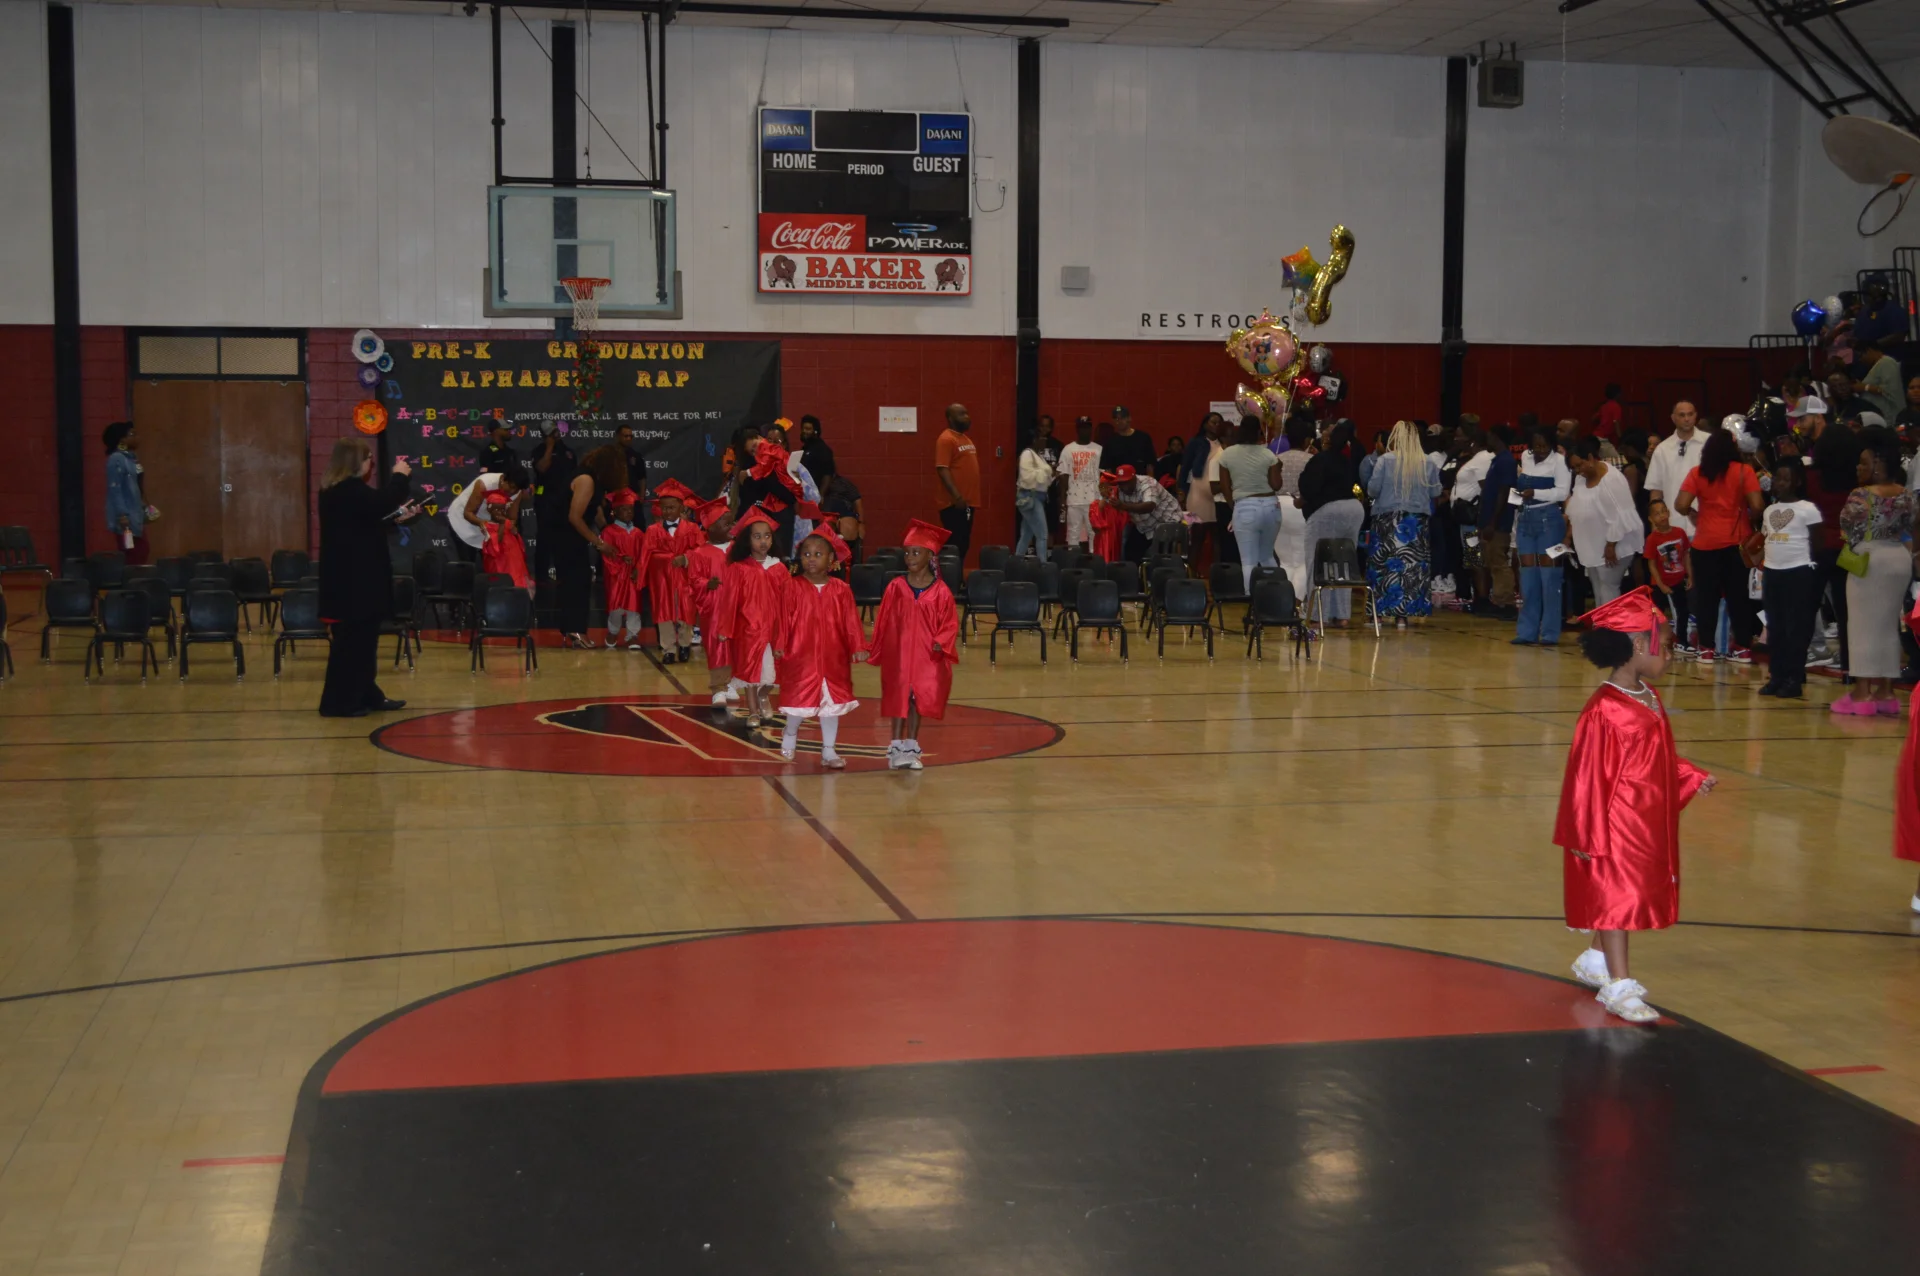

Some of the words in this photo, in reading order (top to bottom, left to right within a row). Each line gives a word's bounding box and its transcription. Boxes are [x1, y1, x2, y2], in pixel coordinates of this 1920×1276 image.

[768, 124, 805, 136] DASANI
[926, 128, 962, 140] DASANI
[773, 153, 816, 169] HOME
[913, 156, 961, 173] GUEST
[848, 164, 884, 175] PERIOD
[772, 221, 855, 250] Coca-Cola
[806, 257, 925, 279] BAKER
[806, 279, 864, 289] MIDDLE
[869, 280, 926, 290] SCHOOL
[1141, 313, 1290, 329] RESTROOS
[412, 342, 491, 359] PRE-K
[547, 341, 704, 359] GRDUATION
[636, 370, 689, 388] RAP
[514, 412, 584, 420] KINDERGARTEN
[617, 412, 629, 420] BE
[632, 412, 648, 420] THE
[653, 411, 679, 420] PLACE
[684, 411, 701, 420] FOR
[570, 430, 589, 438] OUR
[592, 430, 616, 438] BEST
[432, 539, 447, 547] WE
